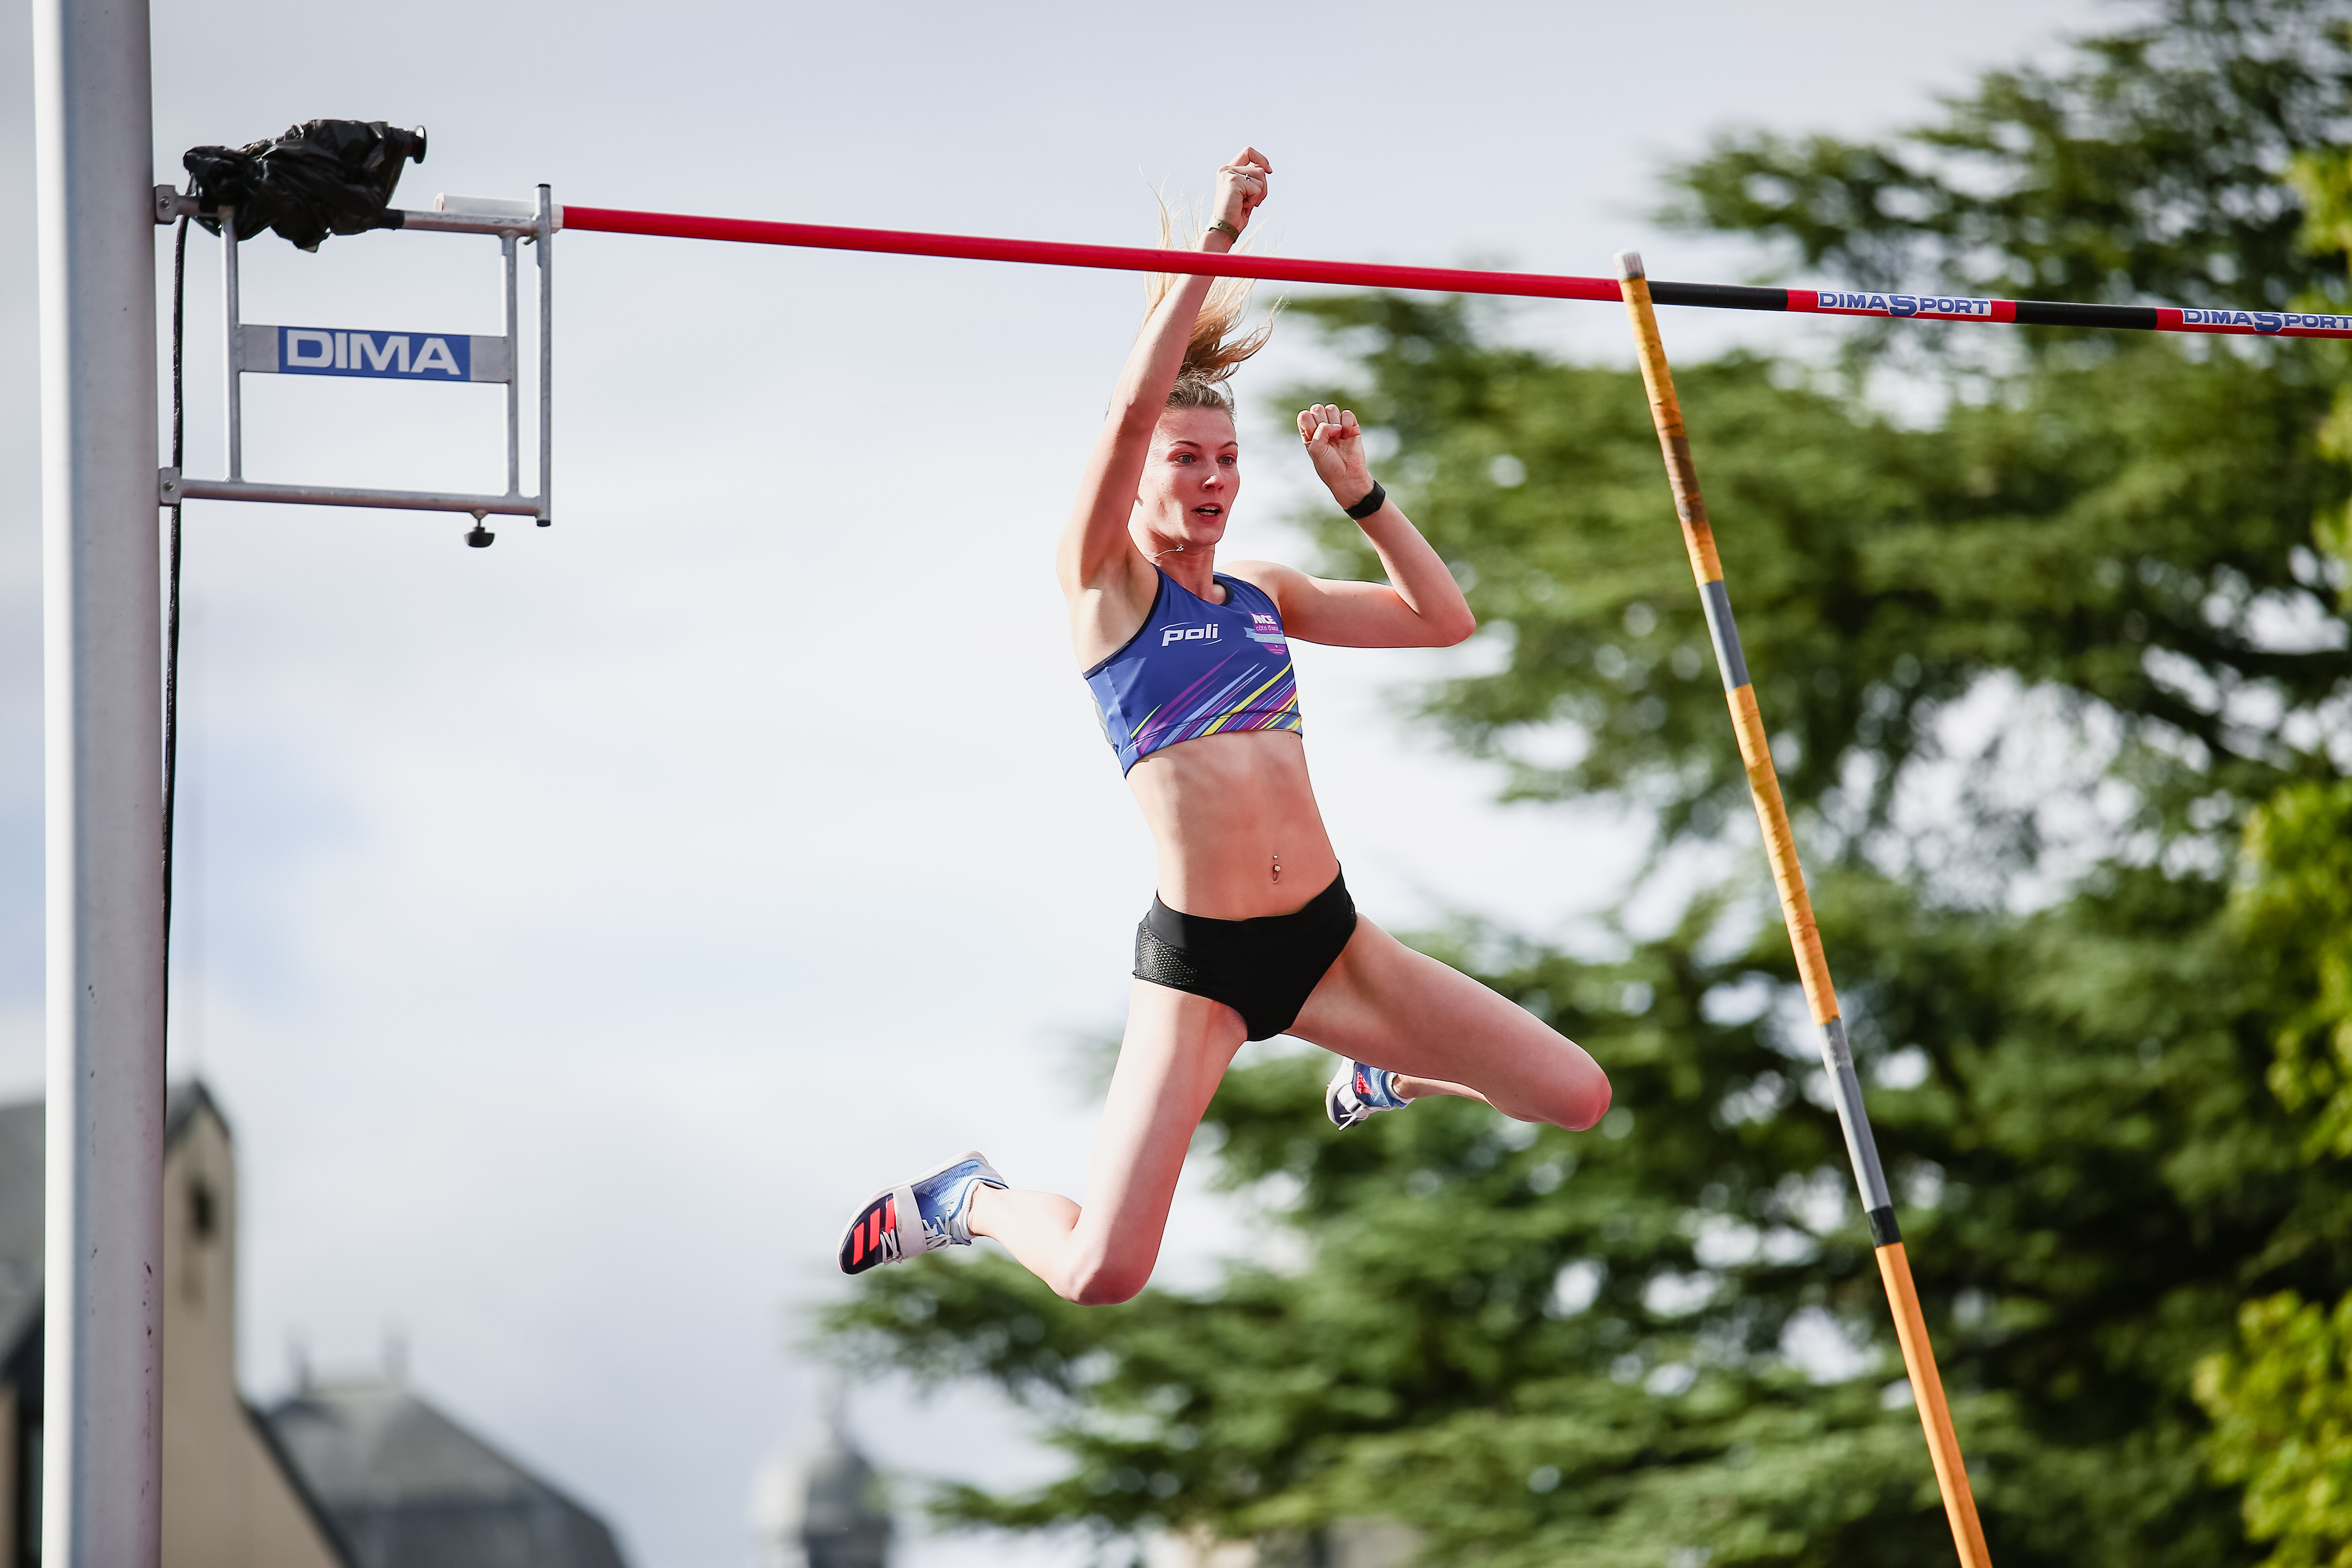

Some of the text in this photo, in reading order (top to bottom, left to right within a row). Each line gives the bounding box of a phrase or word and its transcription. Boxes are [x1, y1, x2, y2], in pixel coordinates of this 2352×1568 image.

[1819, 293, 1989, 315] DIMASPORT
[287, 330, 461, 375] DIMA
[1251, 613, 1277, 624] NICE
[1162, 624, 1218, 646] poli
